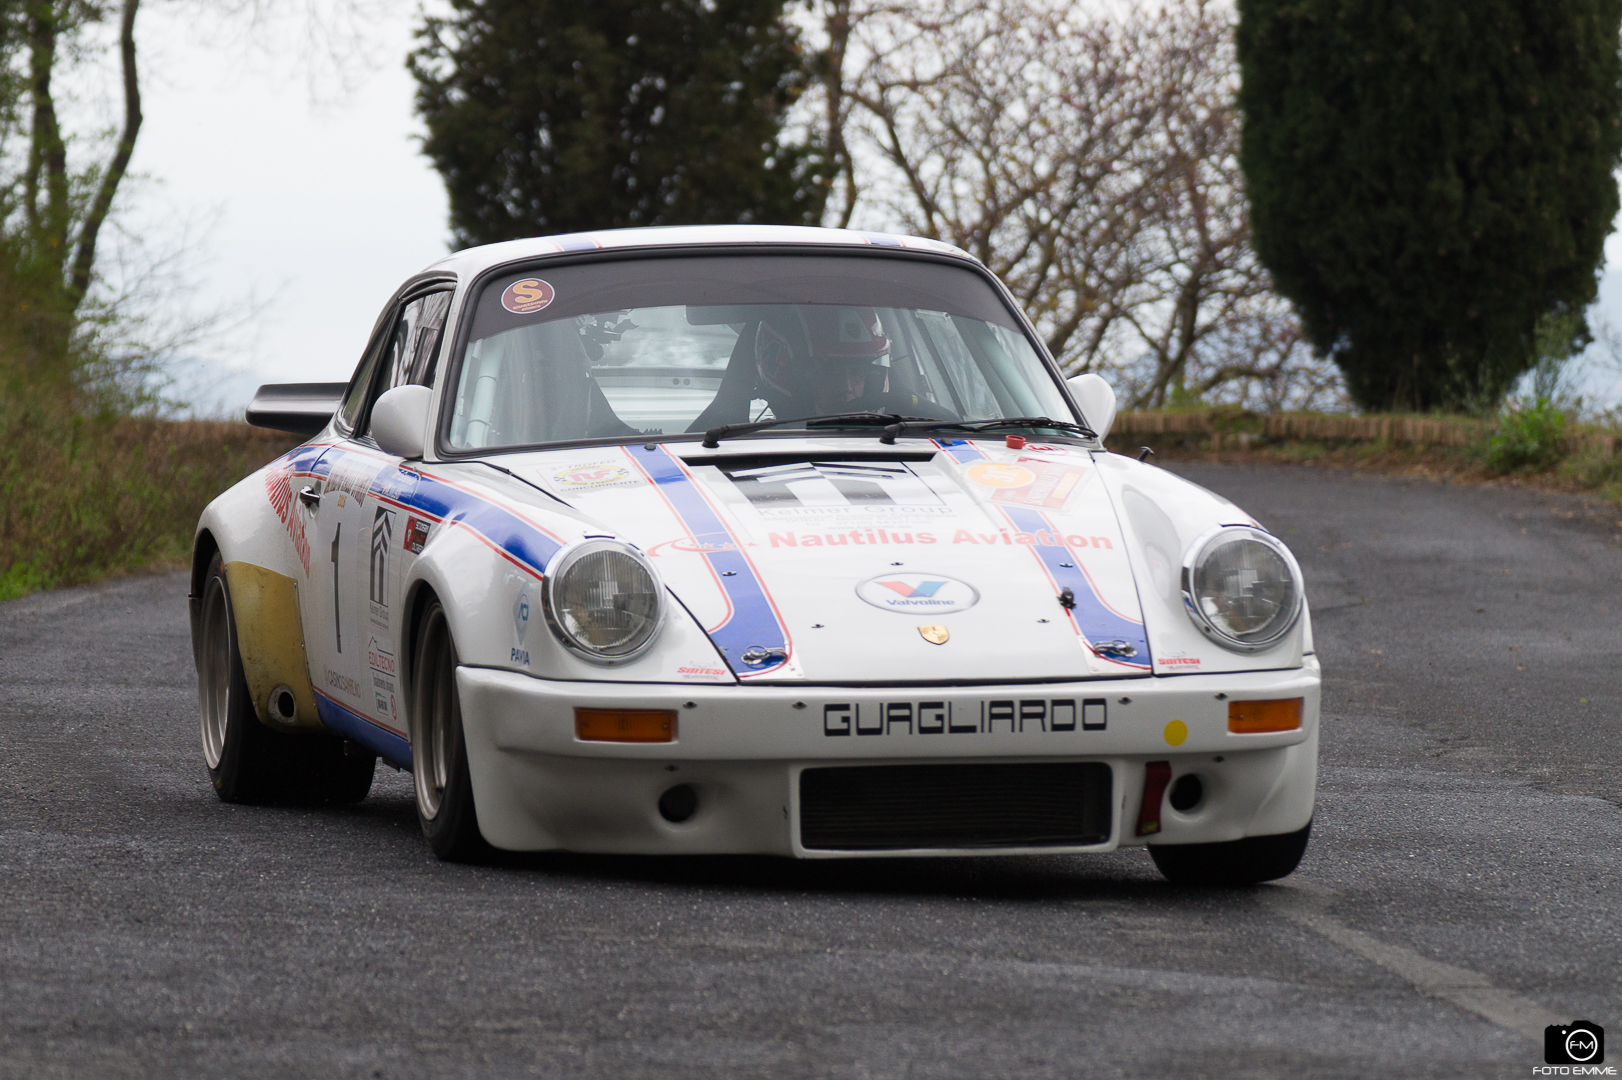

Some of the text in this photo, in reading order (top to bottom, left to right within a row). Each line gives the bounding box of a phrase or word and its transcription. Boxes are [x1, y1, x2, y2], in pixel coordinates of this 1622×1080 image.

[513, 281, 542, 303] S
[757, 506, 953, 517] Kelmer Group
[768, 528, 1113, 549] Nautilus Aviation
[331, 522, 342, 654] 1
[511, 647, 530, 666] PAVIA
[823, 698, 1107, 737] GUAGLIARDO
